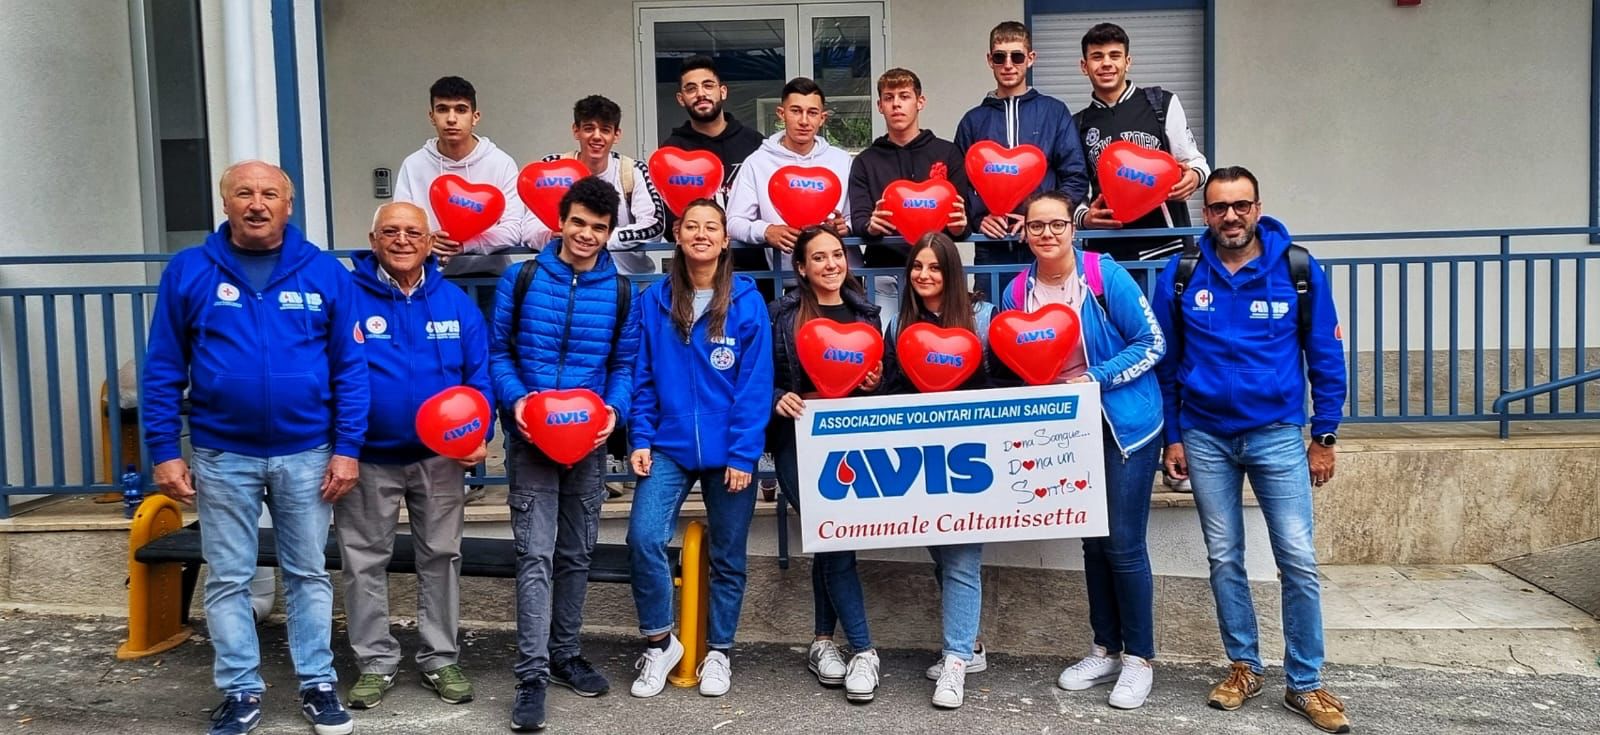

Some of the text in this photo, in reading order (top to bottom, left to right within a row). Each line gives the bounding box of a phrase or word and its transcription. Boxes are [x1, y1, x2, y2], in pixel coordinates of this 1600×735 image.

[983, 162, 1020, 176] AVIS
[1117, 165, 1156, 187] AVIS
[535, 174, 574, 190] AVIS
[668, 175, 705, 187] AVIS
[789, 178, 825, 191] AVIS
[448, 192, 484, 213] AVIS
[902, 196, 937, 210] AVIS
[1016, 327, 1056, 345] AVIS
[823, 346, 864, 364] AVIS
[925, 351, 964, 368] AVIS
[545, 409, 590, 425] AVIS
[818, 401, 1073, 430] ASSOCIAZIONE VOLONTARI ITALIANI SANGUE
[443, 417, 481, 442] AVIS
[1057, 451, 1076, 465] un
[817, 442, 994, 501] AVIS
[818, 507, 1088, 540] Comunale Caltanissetta
